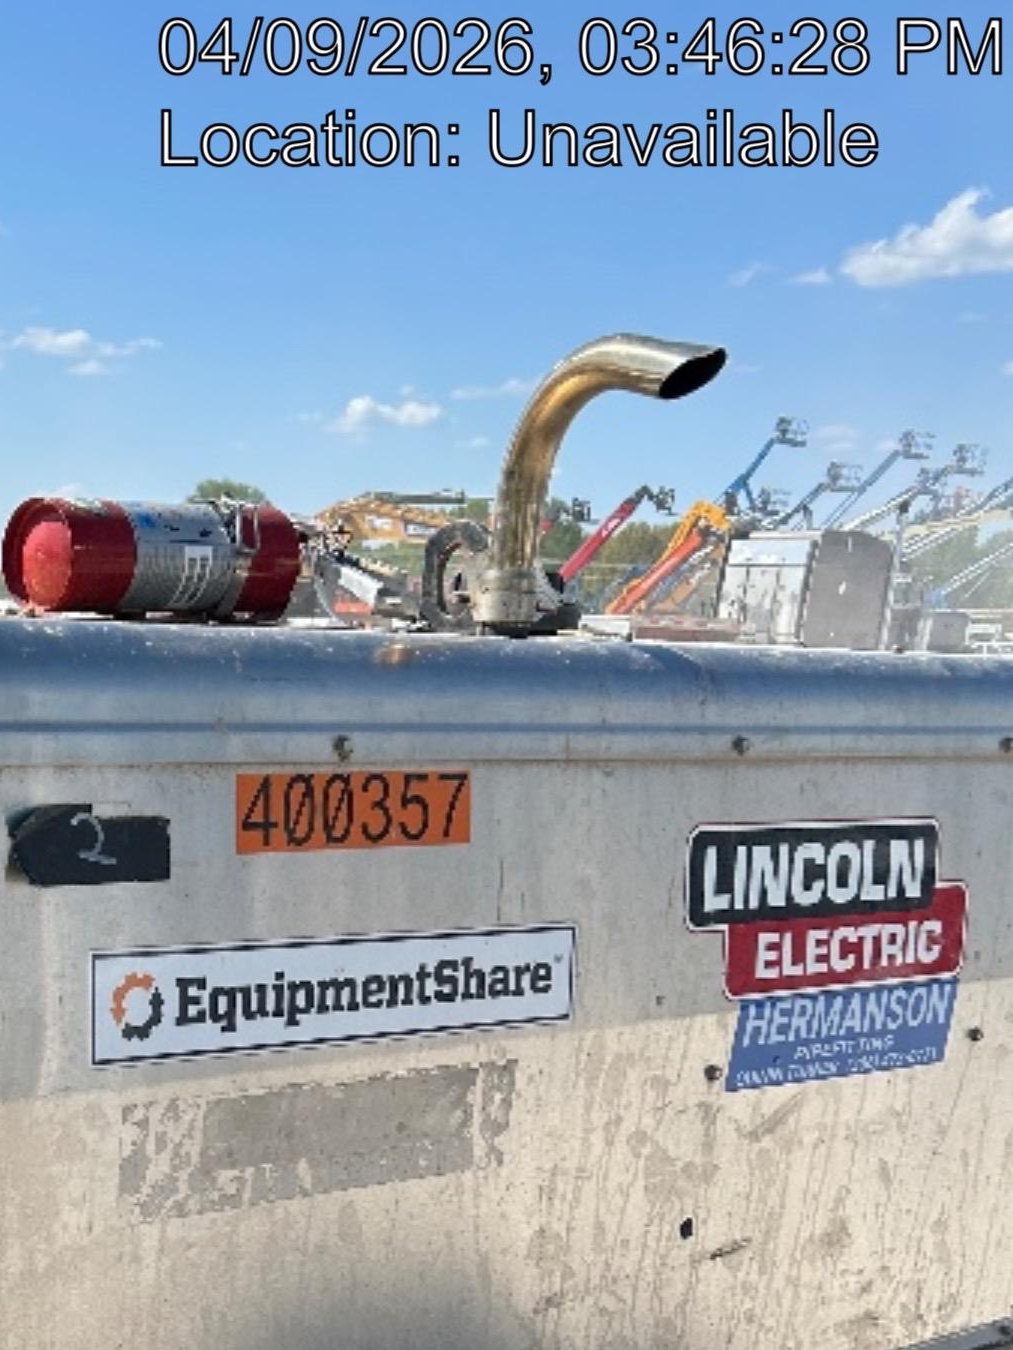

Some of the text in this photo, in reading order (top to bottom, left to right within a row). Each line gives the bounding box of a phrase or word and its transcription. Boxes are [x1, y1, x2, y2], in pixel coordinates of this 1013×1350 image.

[70, 811, 118, 866] 2
[240, 771, 469, 847] 400357
[702, 838, 925, 913] LINCOLN
[754, 919, 943, 980] ELECTRIC
[174, 955, 554, 1033] EquipmentShare
[742, 983, 952, 1048] HERMANSON
